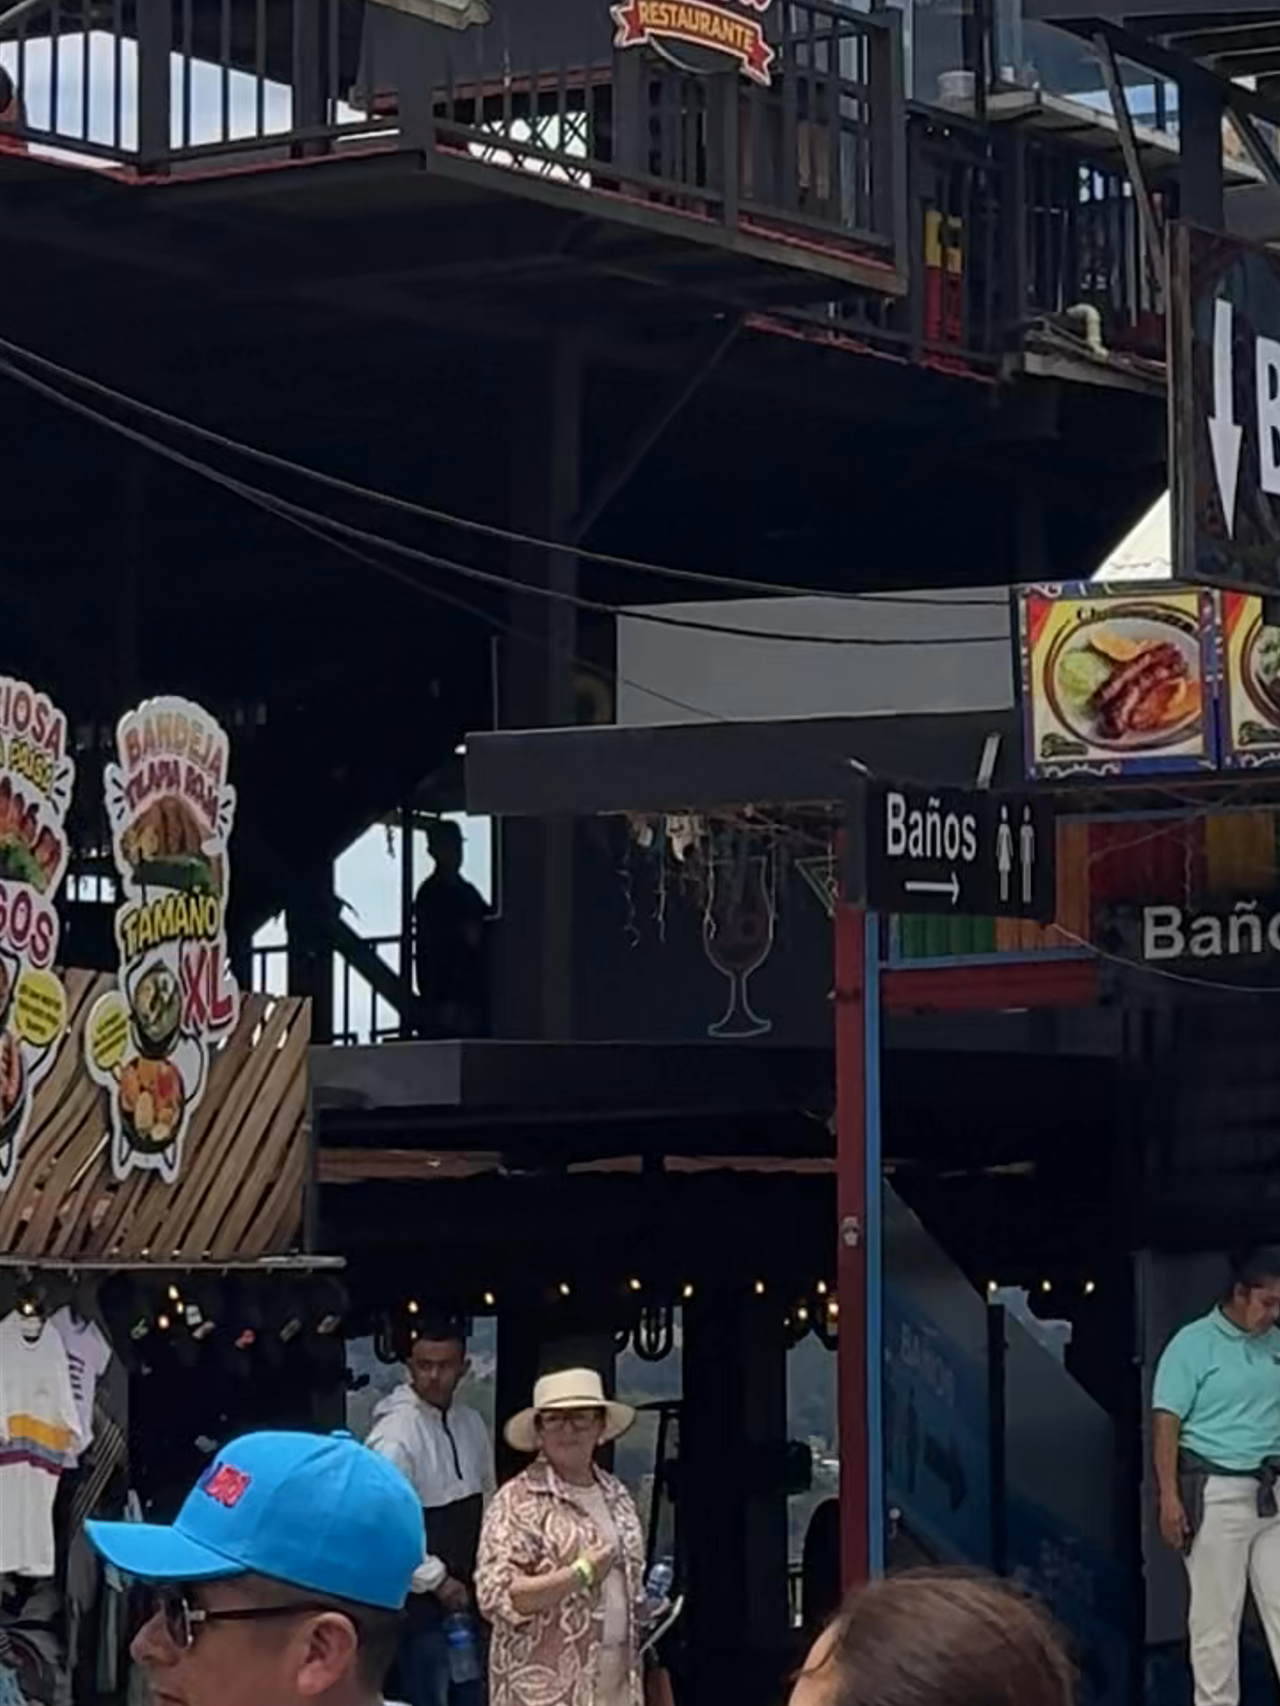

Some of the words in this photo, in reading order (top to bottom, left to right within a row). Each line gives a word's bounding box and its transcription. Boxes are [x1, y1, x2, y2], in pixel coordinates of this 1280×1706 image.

[637, 0, 757, 52] RESTAURANTE
[125, 710, 223, 786] BANDEJA
[885, 792, 978, 863] Baños
[183, 943, 234, 1029] XL
